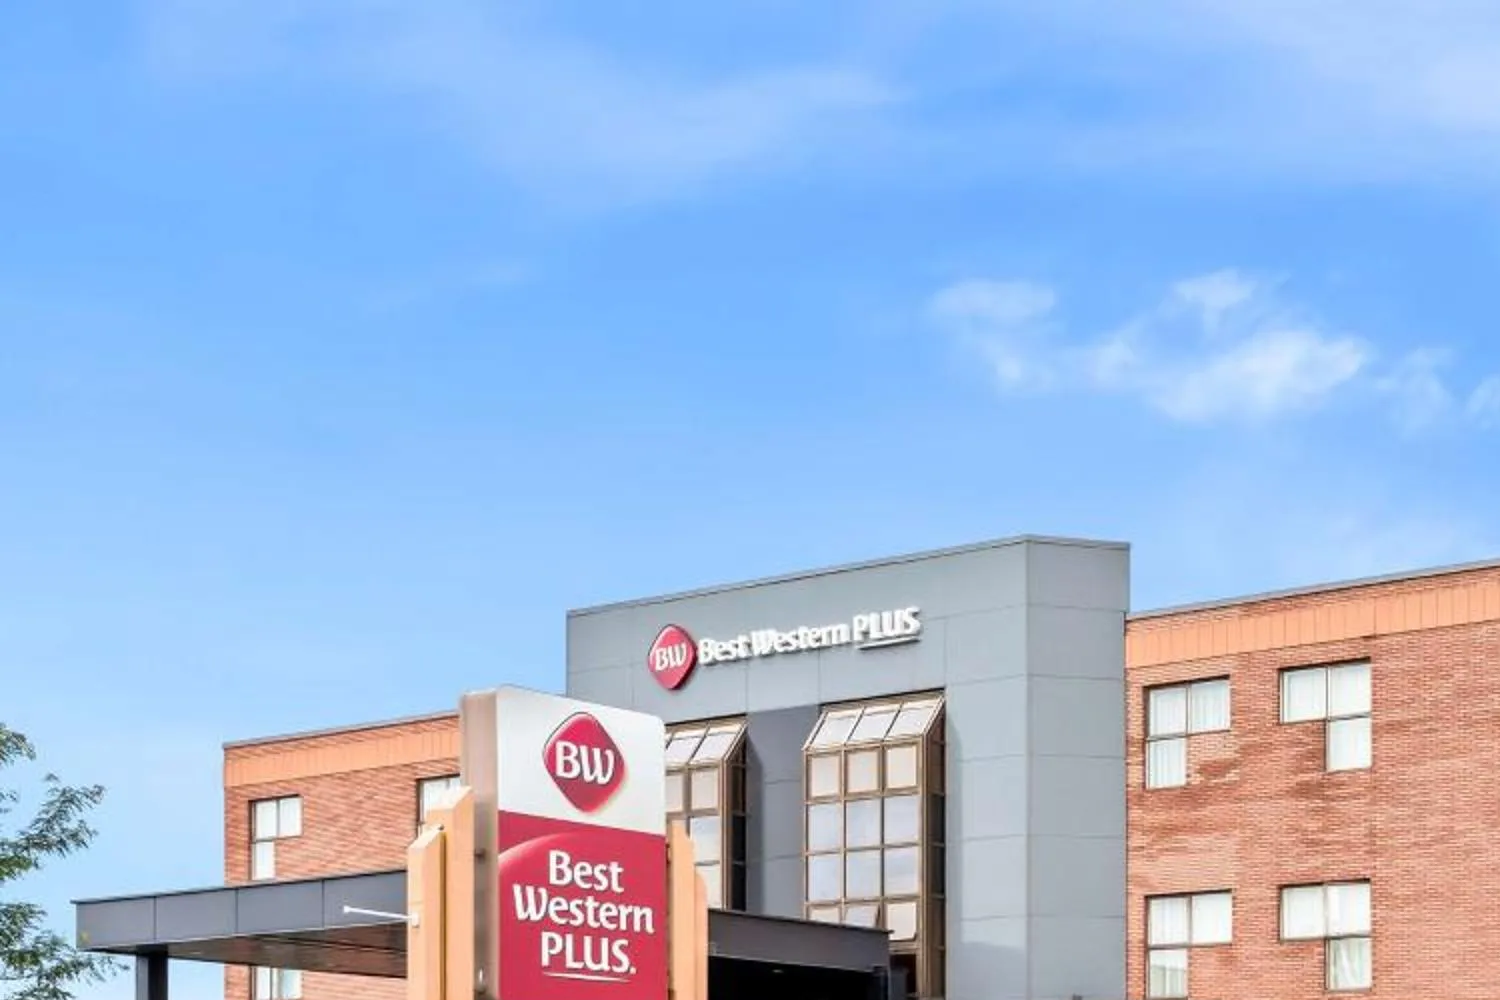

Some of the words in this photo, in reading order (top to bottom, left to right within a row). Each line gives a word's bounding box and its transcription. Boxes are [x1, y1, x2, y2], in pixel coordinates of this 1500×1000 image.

[655, 642, 686, 671] BW
[697, 637, 752, 665] Best
[751, 623, 850, 655] Western
[852, 606, 922, 641] PLUS
[554, 741, 615, 786] BW
[549, 850, 625, 893] Best
[513, 884, 655, 934] Western
